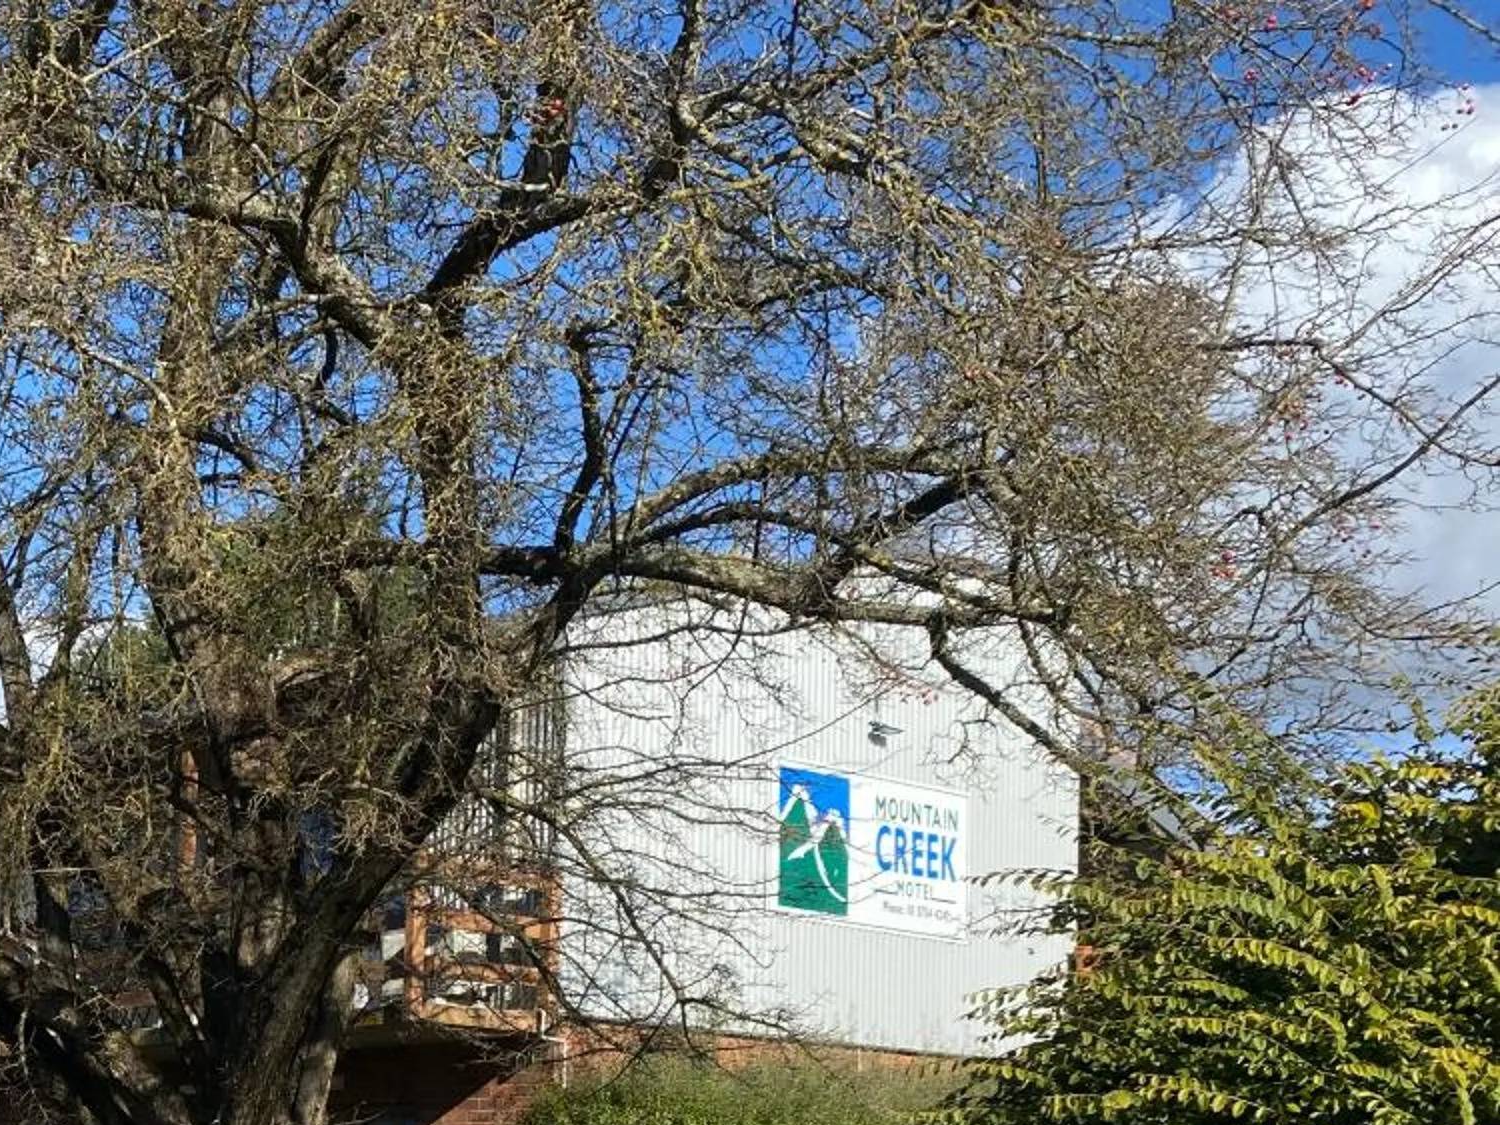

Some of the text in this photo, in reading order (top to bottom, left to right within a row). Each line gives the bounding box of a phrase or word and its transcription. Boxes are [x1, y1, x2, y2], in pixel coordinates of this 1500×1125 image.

[875, 795, 959, 832] MOUNTAIN
[875, 825, 957, 882] CREEK
[895, 880, 934, 900] MOTEL
